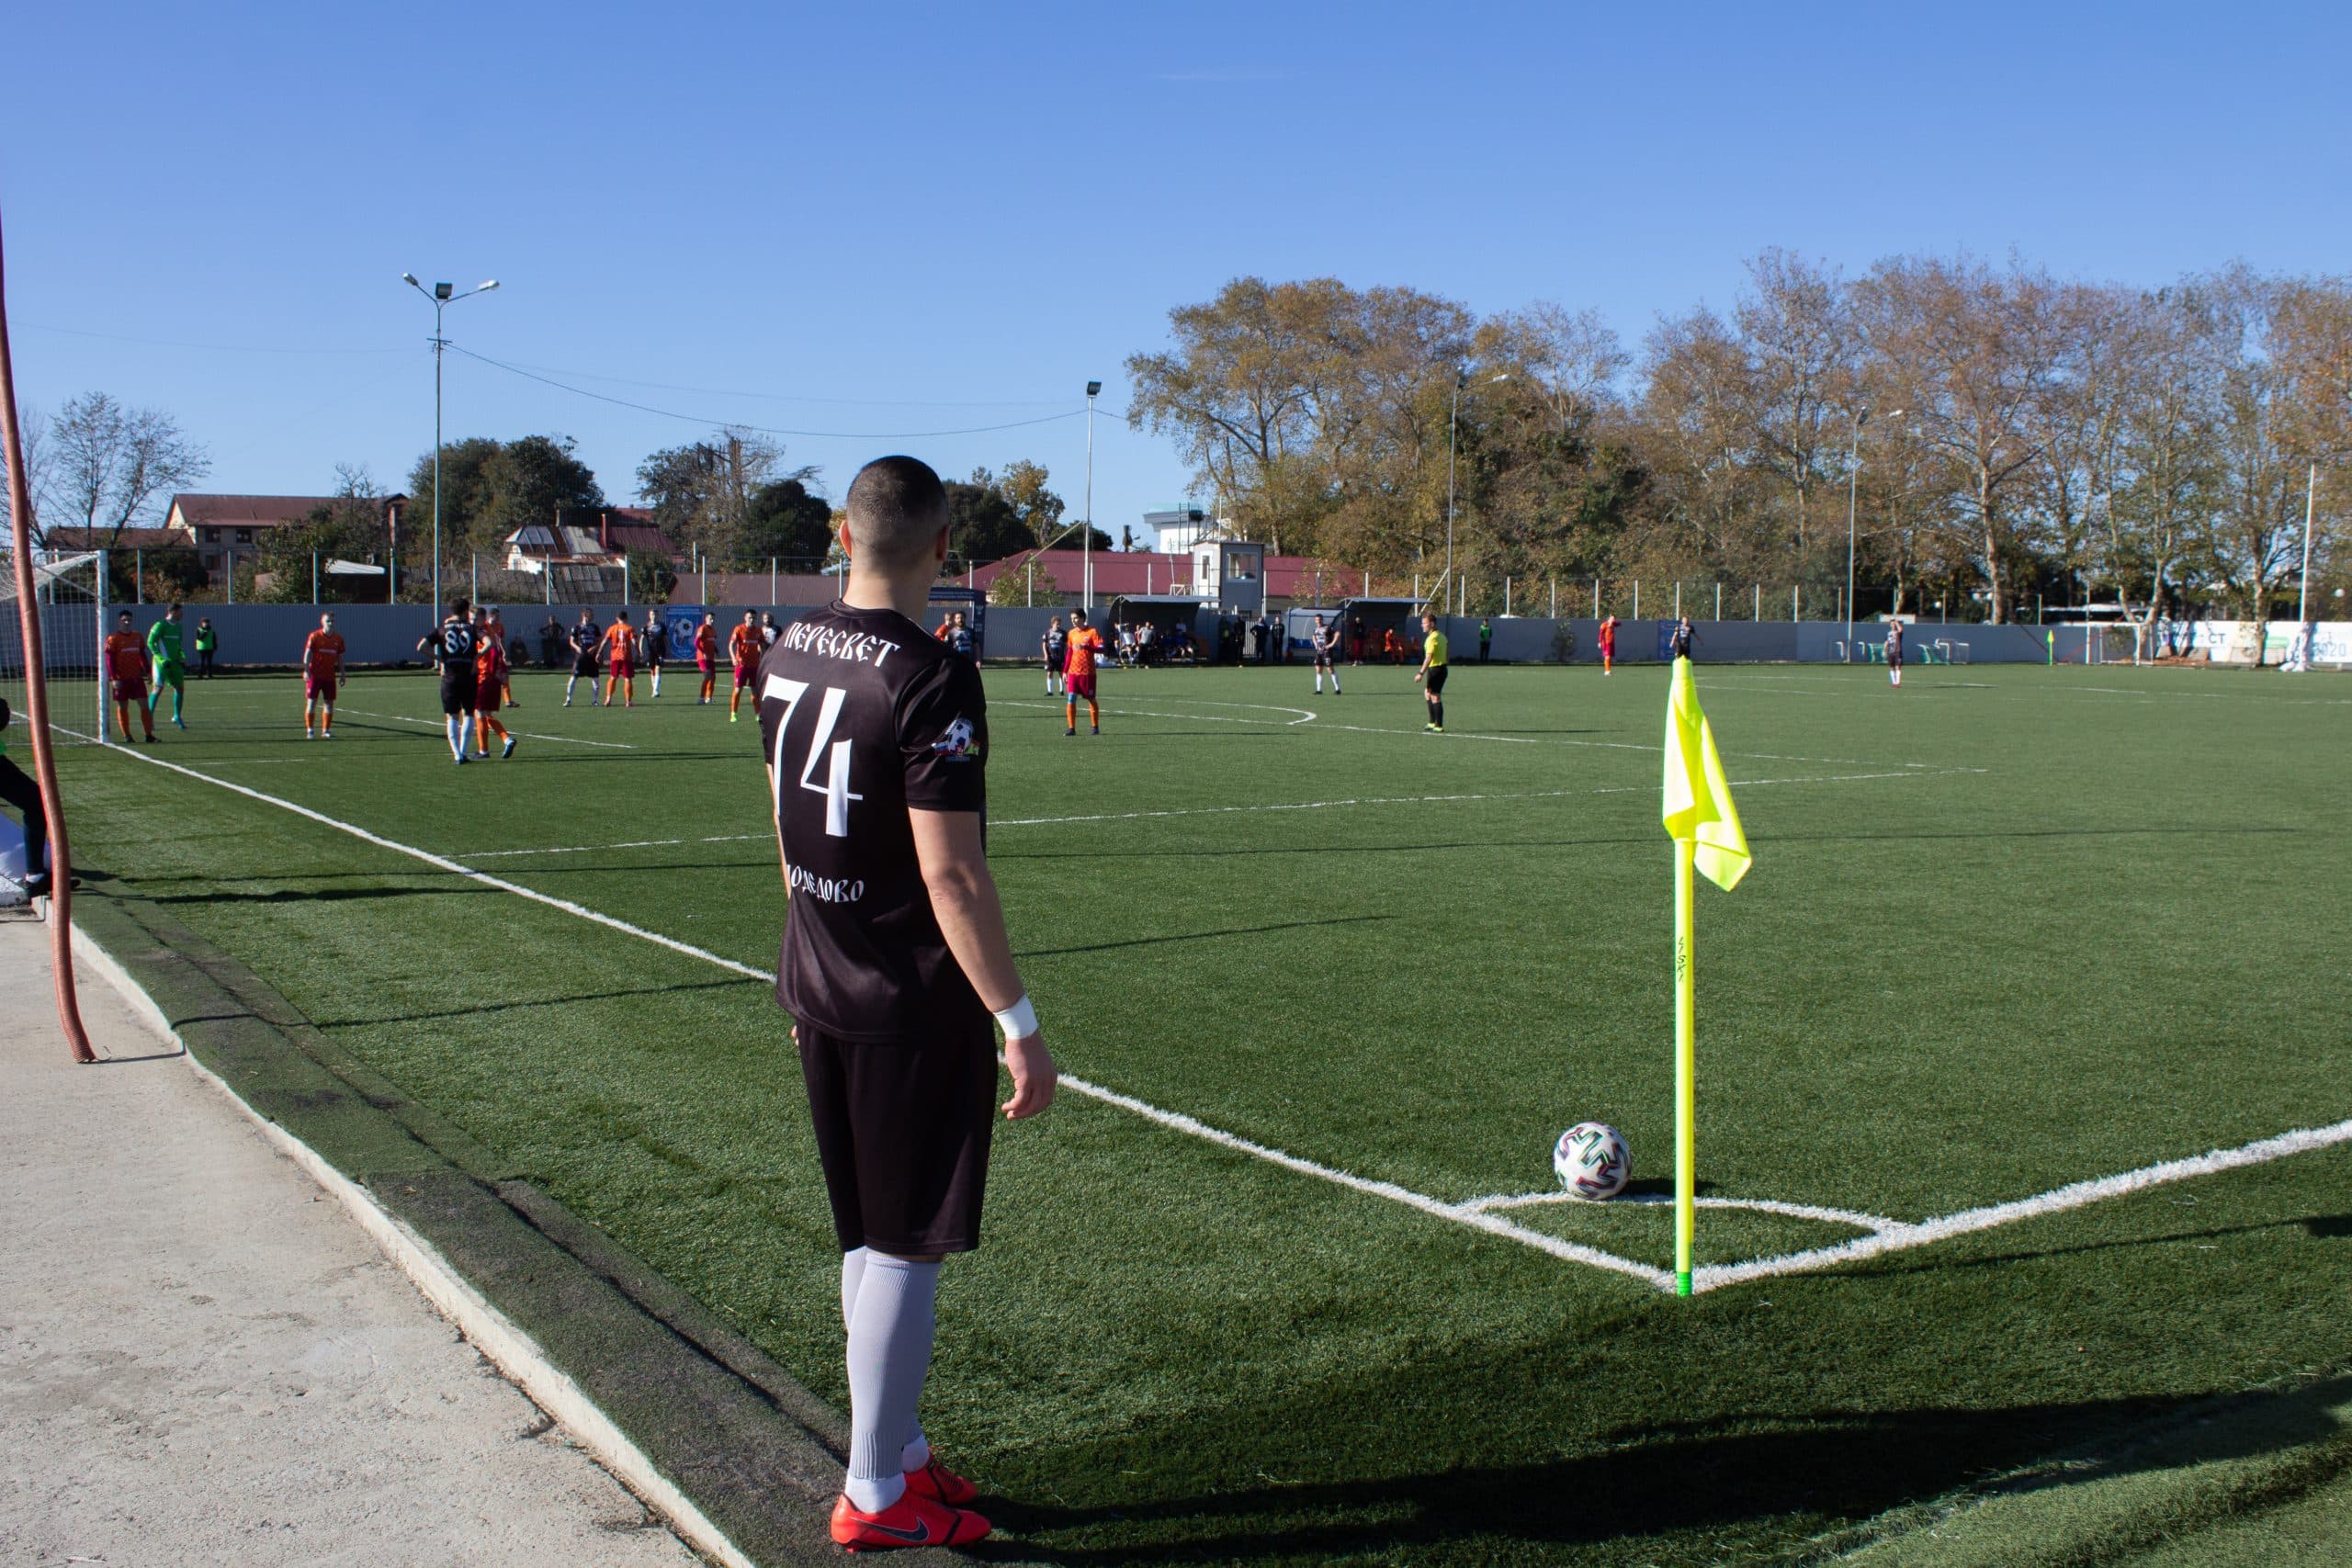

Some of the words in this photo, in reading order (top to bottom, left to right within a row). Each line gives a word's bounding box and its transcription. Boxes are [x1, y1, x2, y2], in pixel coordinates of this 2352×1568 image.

[445, 630, 471, 654] 89
[784, 622, 901, 667] ПЕРЕСВЕТ
[762, 673, 864, 838] 74
[786, 863, 865, 904] ОДЕДОВО
